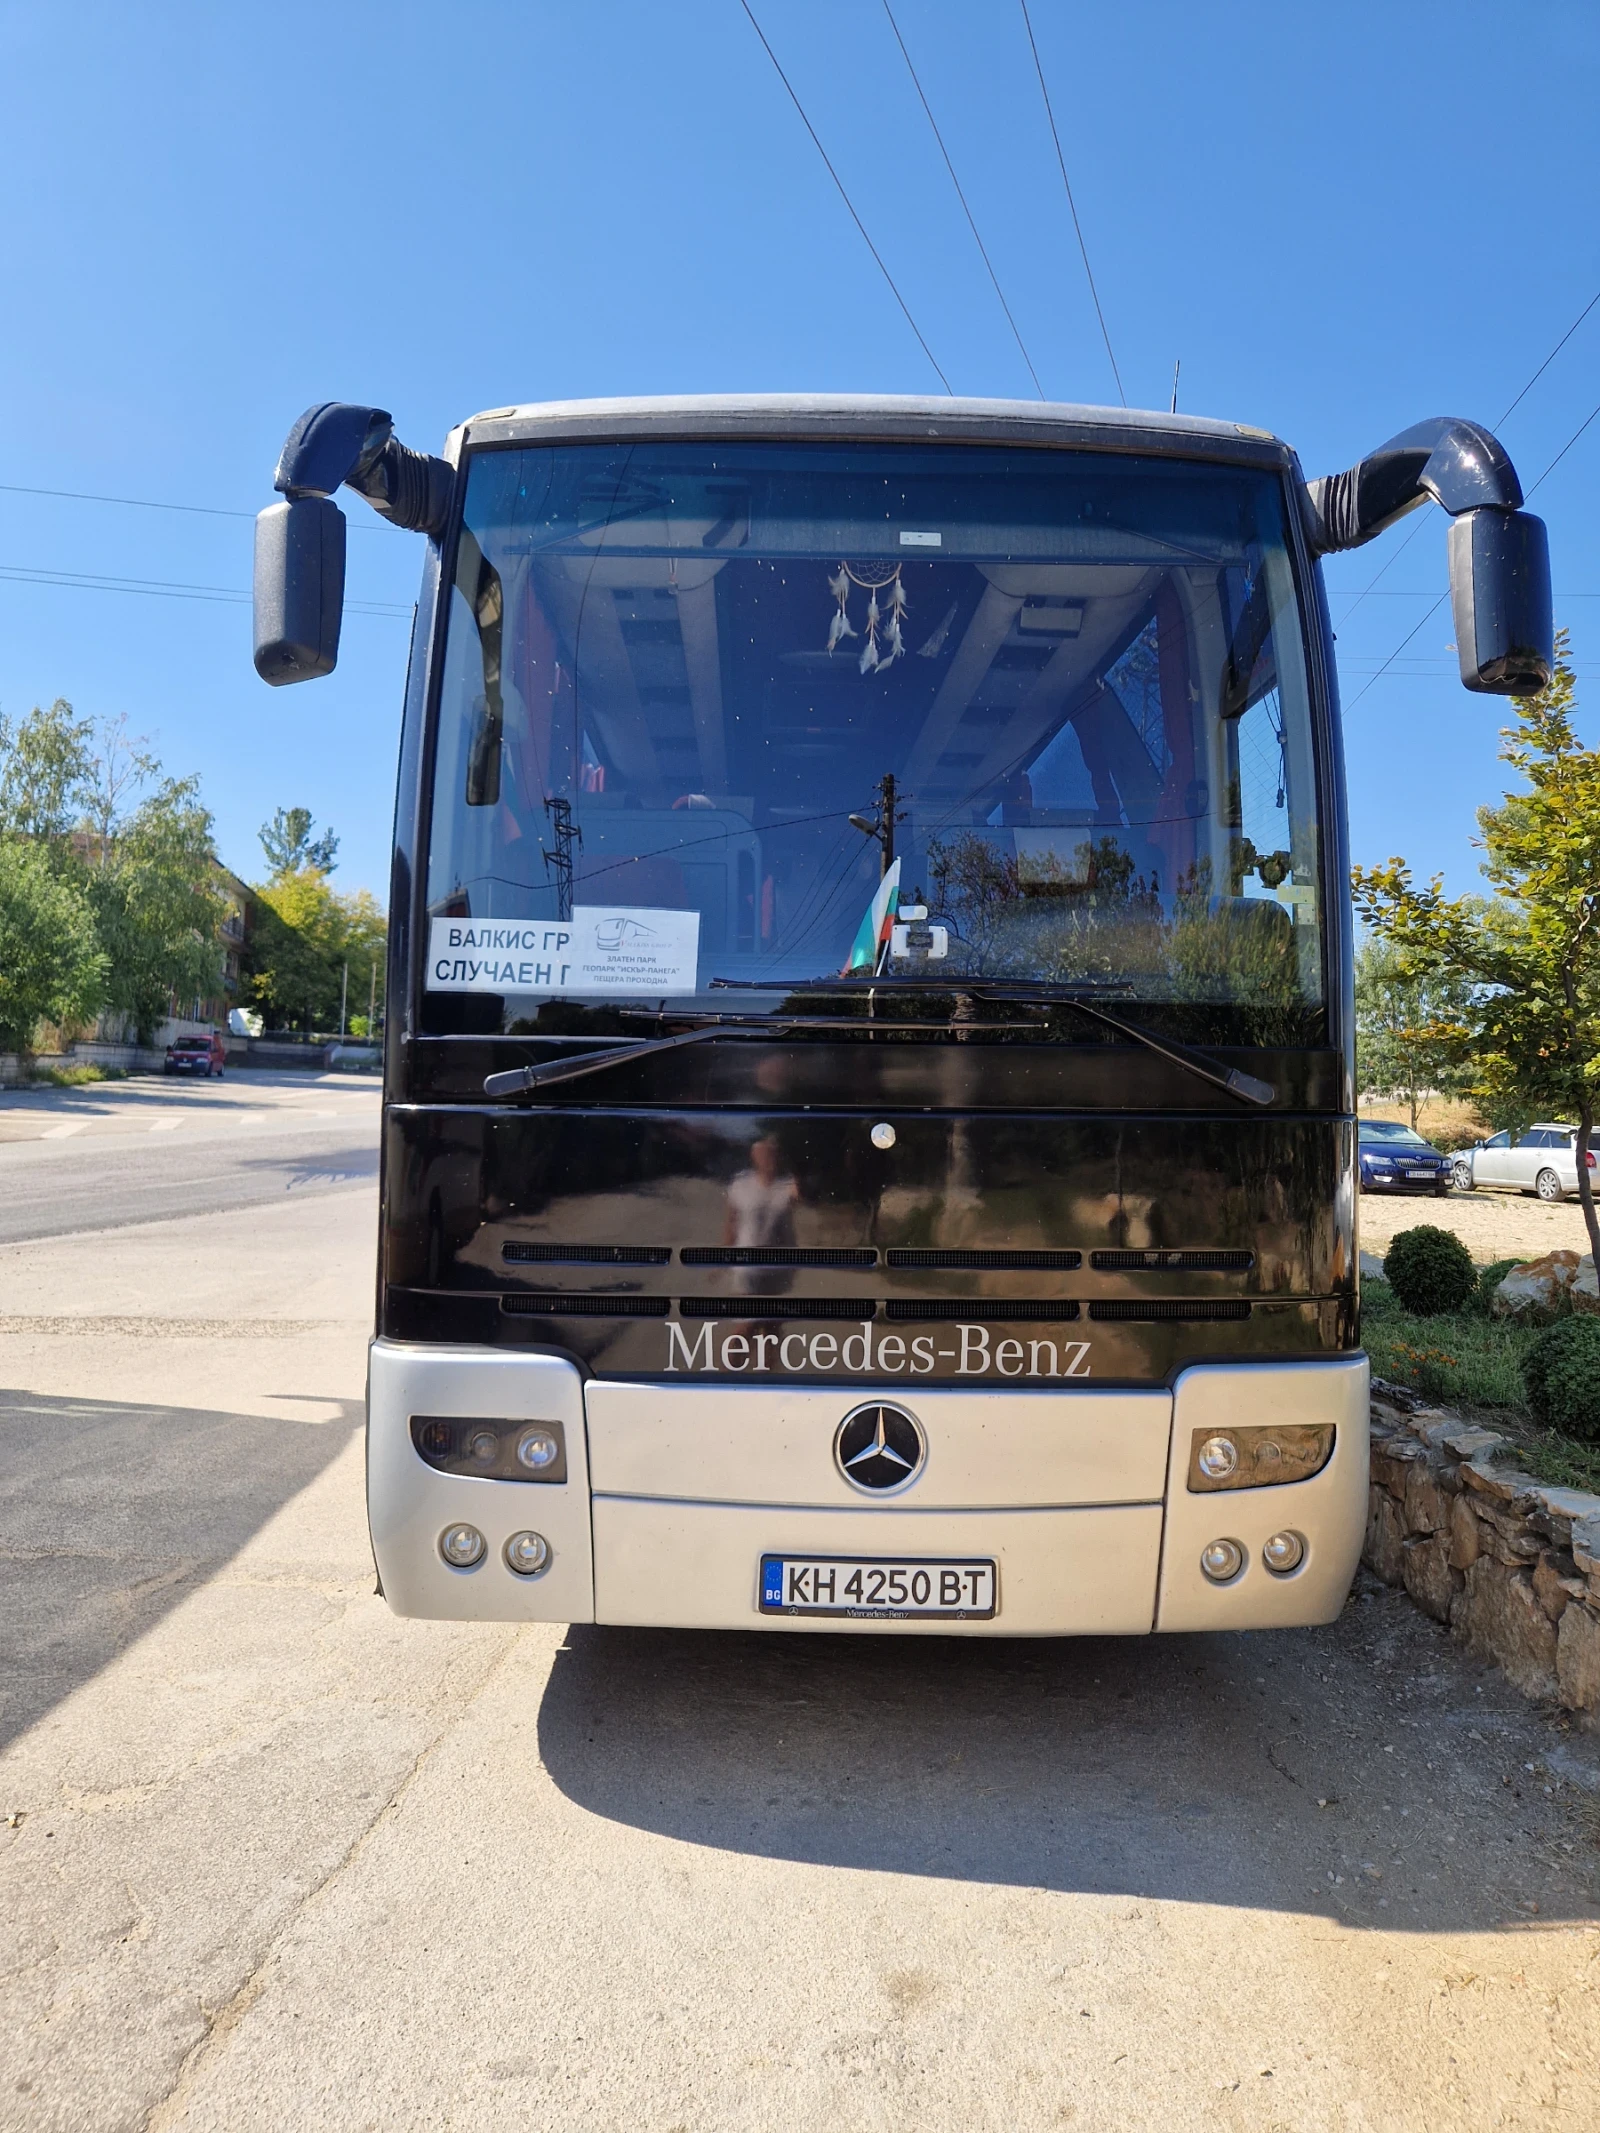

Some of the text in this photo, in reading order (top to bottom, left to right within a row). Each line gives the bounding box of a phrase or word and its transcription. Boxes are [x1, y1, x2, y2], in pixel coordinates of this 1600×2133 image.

[448, 928, 571, 951] ВАЛКИС ГР
[607, 955, 657, 964] ЗЛАТЕН ПАРК
[435, 959, 552, 985] СЛУЧАЕН
[582, 964, 616, 973] ГЕОПАРК
[593, 975, 668, 985] ПЕЩЕРА ПРОХОДНА
[663, 1321, 1092, 1377] Mercedes-Benz
[844, 1569, 932, 1605] 4250
[765, 1589, 781, 1601] BG
[846, 1608, 910, 1619] Mercedes-Benz
